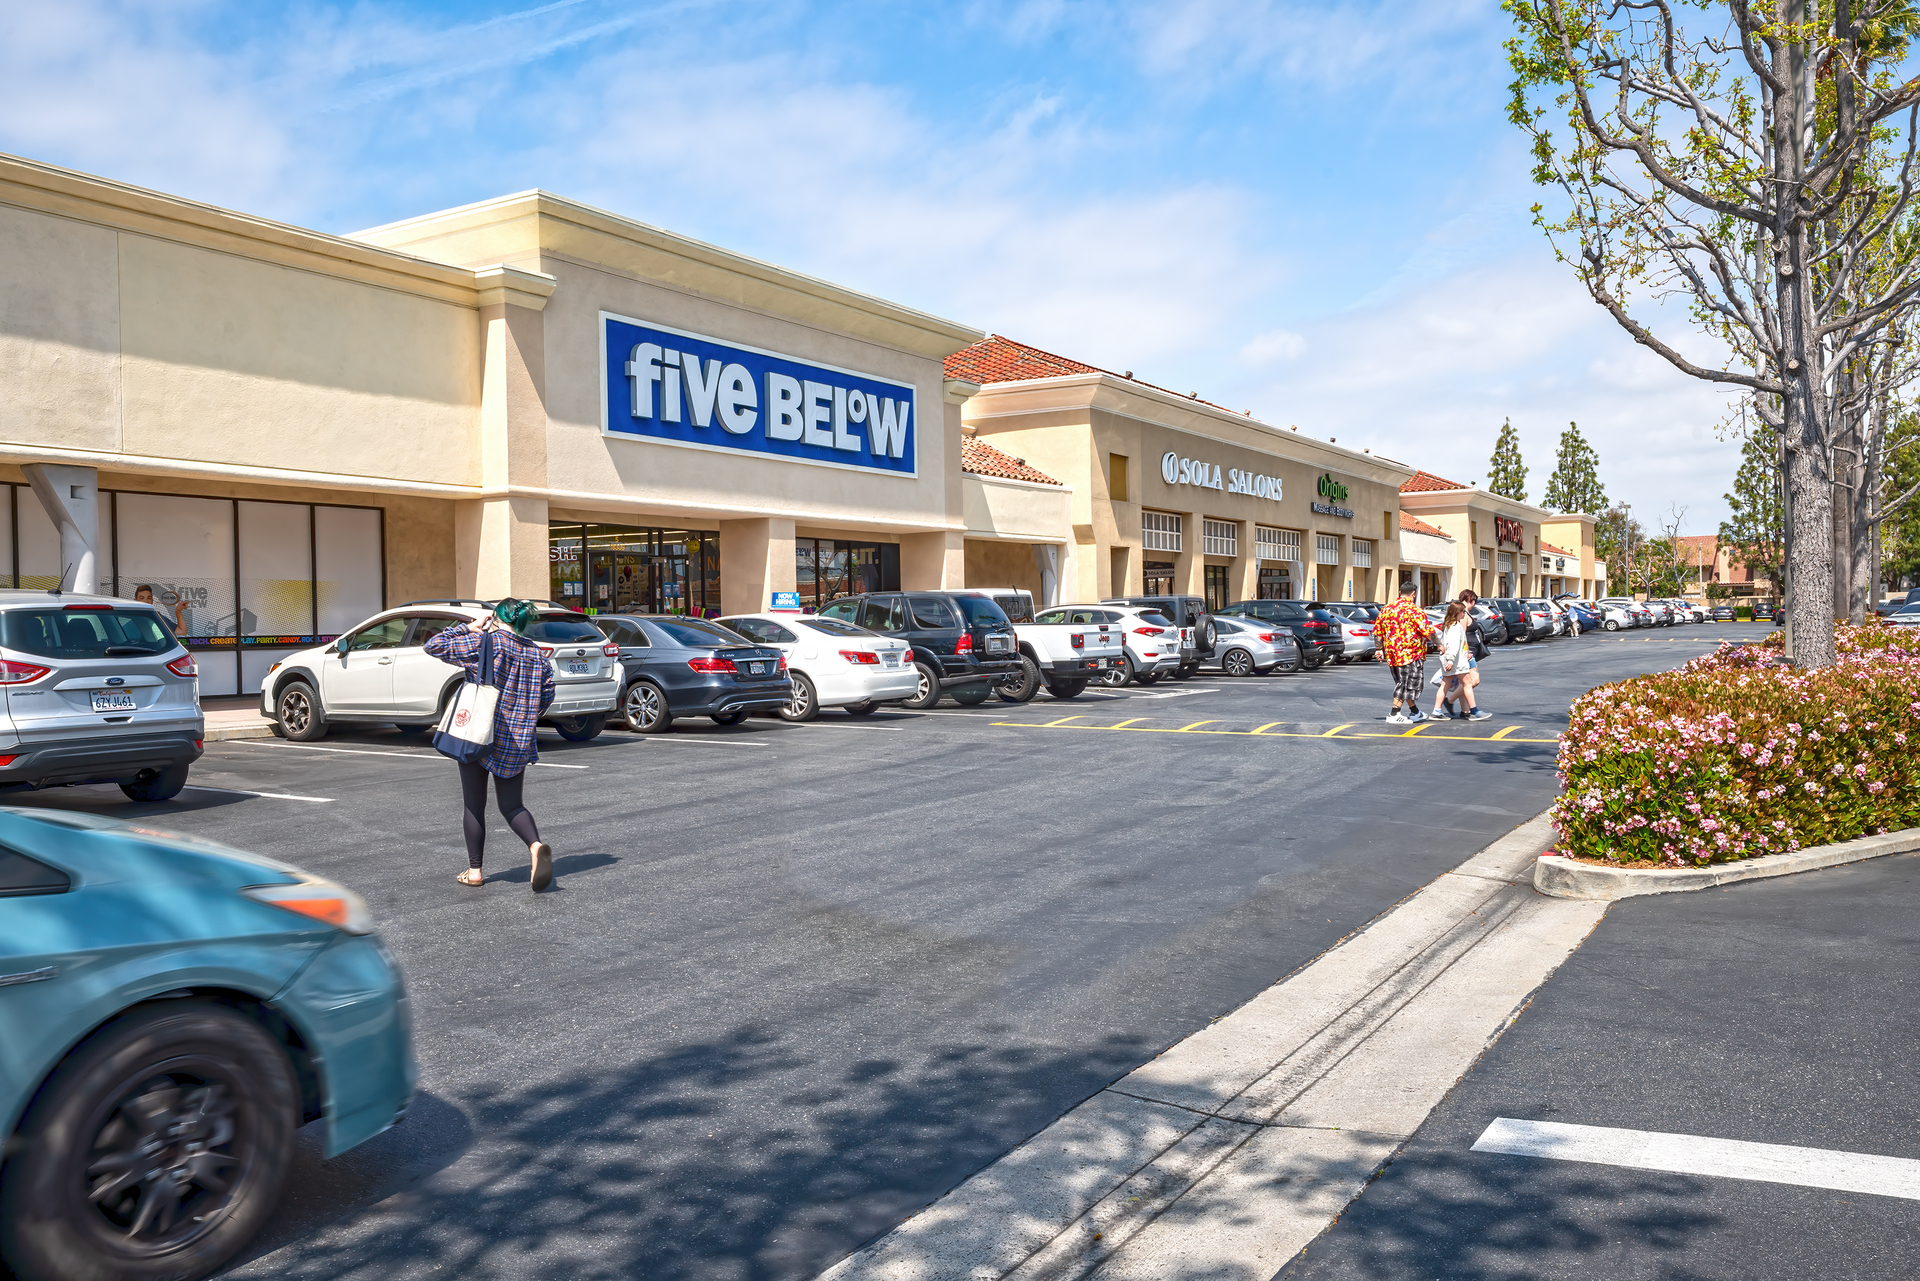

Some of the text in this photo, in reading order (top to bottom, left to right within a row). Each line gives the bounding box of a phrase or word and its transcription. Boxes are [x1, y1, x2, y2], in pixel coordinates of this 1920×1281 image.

[625, 342, 910, 459] five BELOW
[1179, 458, 1282, 501] SOLA SALONS
[1318, 474, 1349, 503] Origins
[1099, 634, 1110, 643] Jeep
[96, 696, 133, 708] 6ZYJ461
